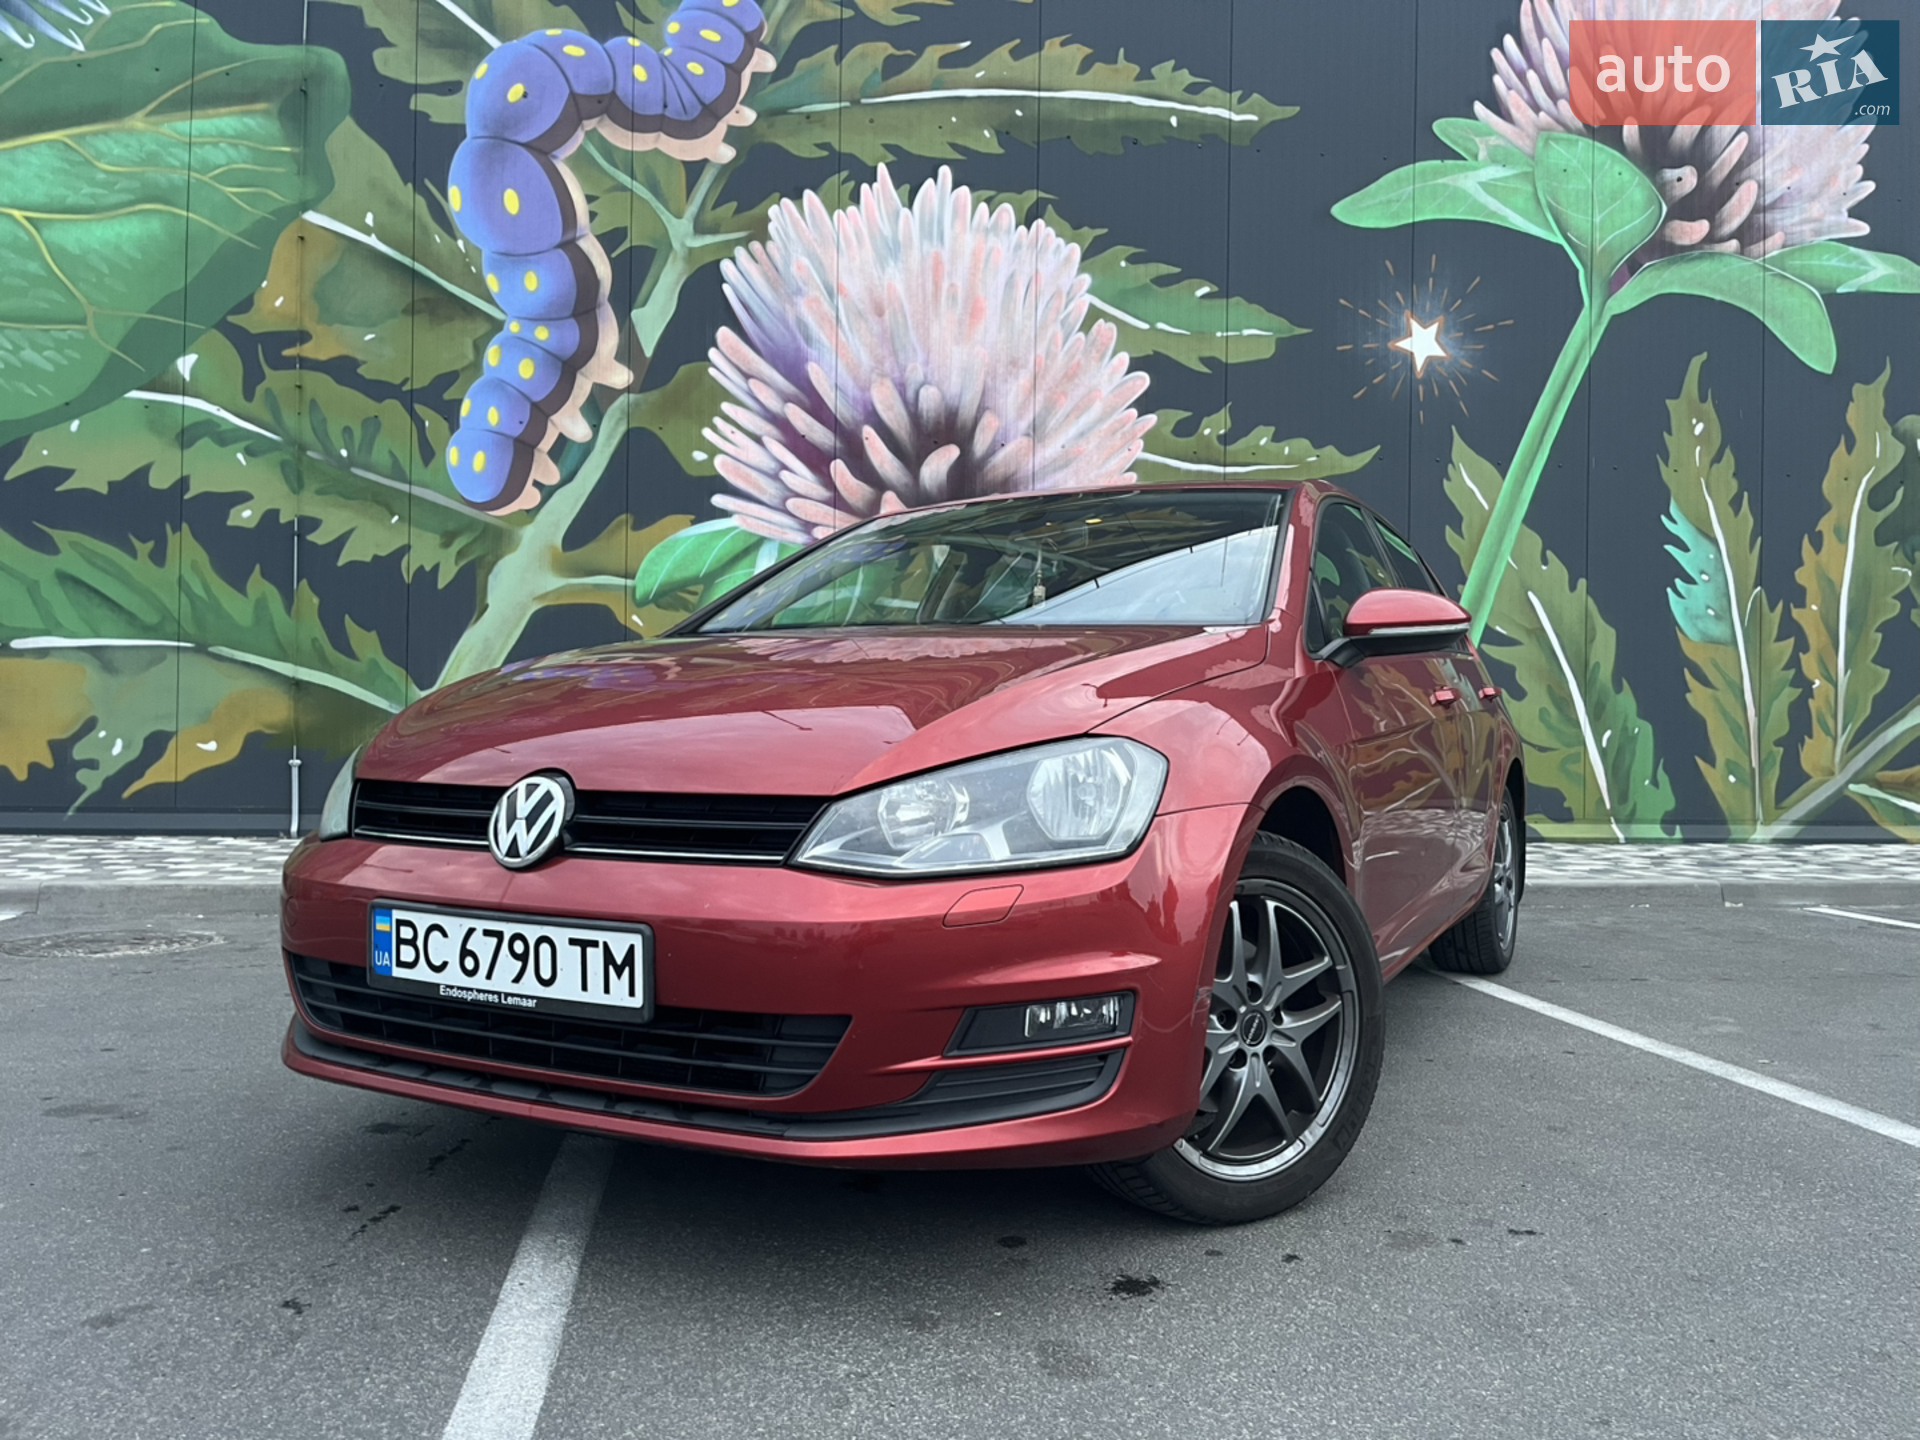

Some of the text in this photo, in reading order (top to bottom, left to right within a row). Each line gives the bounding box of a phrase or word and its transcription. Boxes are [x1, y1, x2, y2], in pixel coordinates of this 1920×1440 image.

[375, 950, 391, 967] UA
[395, 918, 635, 998] BC 6790 TM
[439, 985, 537, 1008] Endospheres Lemaar
